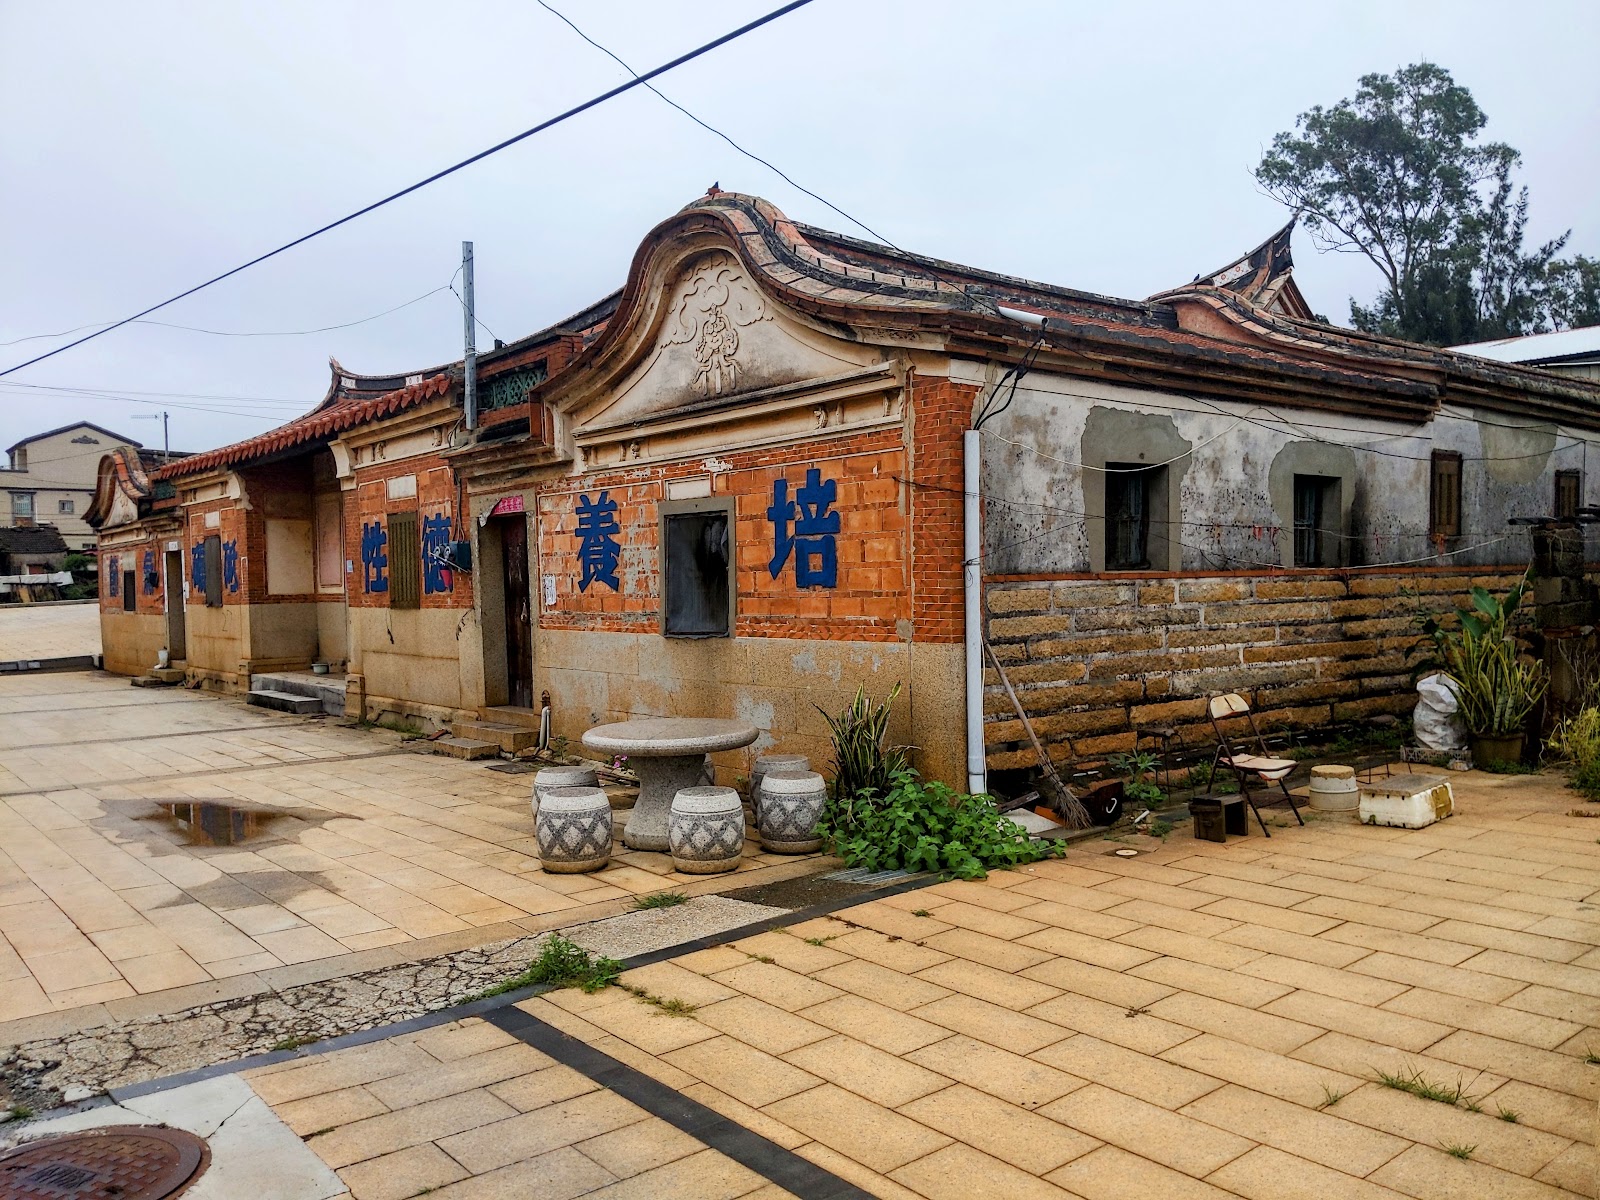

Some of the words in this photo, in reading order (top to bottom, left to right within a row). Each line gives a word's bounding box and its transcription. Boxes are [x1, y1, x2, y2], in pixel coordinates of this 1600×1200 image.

[361, 521, 389, 595] 性
[574, 490, 621, 593] 養
[767, 468, 841, 589] 培
